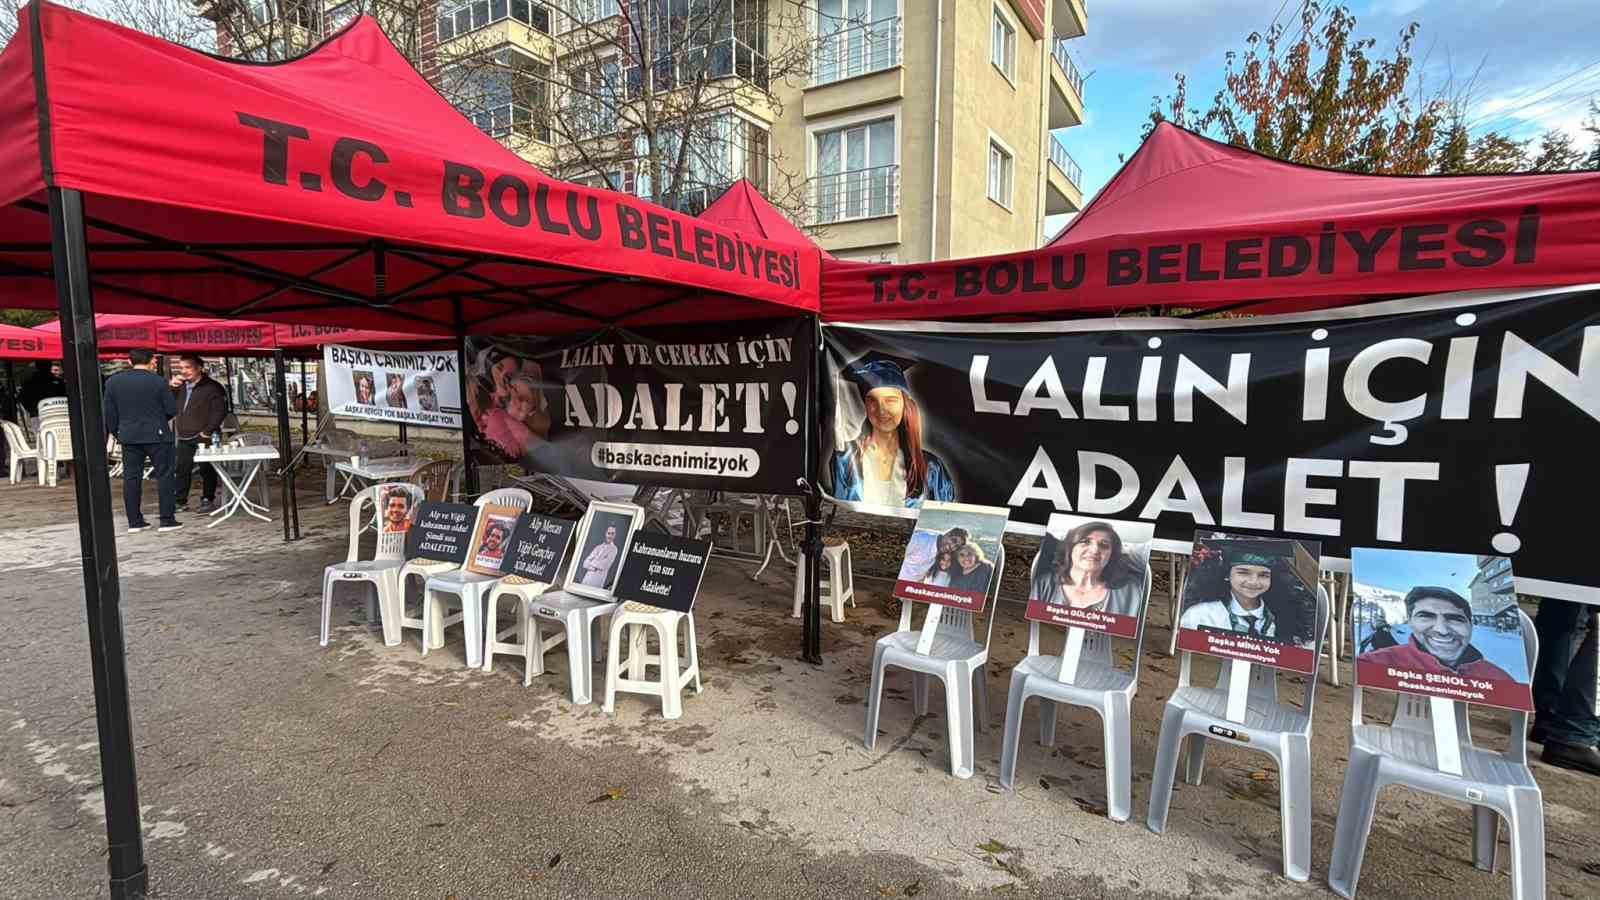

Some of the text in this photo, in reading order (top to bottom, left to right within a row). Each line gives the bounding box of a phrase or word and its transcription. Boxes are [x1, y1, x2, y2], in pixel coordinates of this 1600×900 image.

[235, 111, 800, 290] T.C. BOLU BELEDİYESİ
[866, 205, 1541, 304] T.C. BOLU BELEDİYESİ
[332, 347, 373, 368] BAŞKA
[429, 355, 456, 372] YOK
[560, 333, 793, 369] LALİN VE CEREN İÇİN
[969, 312, 1600, 446] LALİN İÇİN
[384, 408, 395, 418] YOK
[563, 381, 800, 436] ADALET !
[598, 447, 749, 474] #baskacanimizyok
[1006, 444, 1531, 554] ADALET !
[428, 510, 441, 521] Alp
[529, 517, 542, 533] Alp
[648, 561, 662, 576] için
[1046, 605, 1069, 617] Başka
[1101, 614, 1116, 624] Yok
[1207, 635, 1236, 649] Başka
[1263, 644, 1281, 656] Yok
[1387, 667, 1494, 691] Başka ŞENOL Yok
